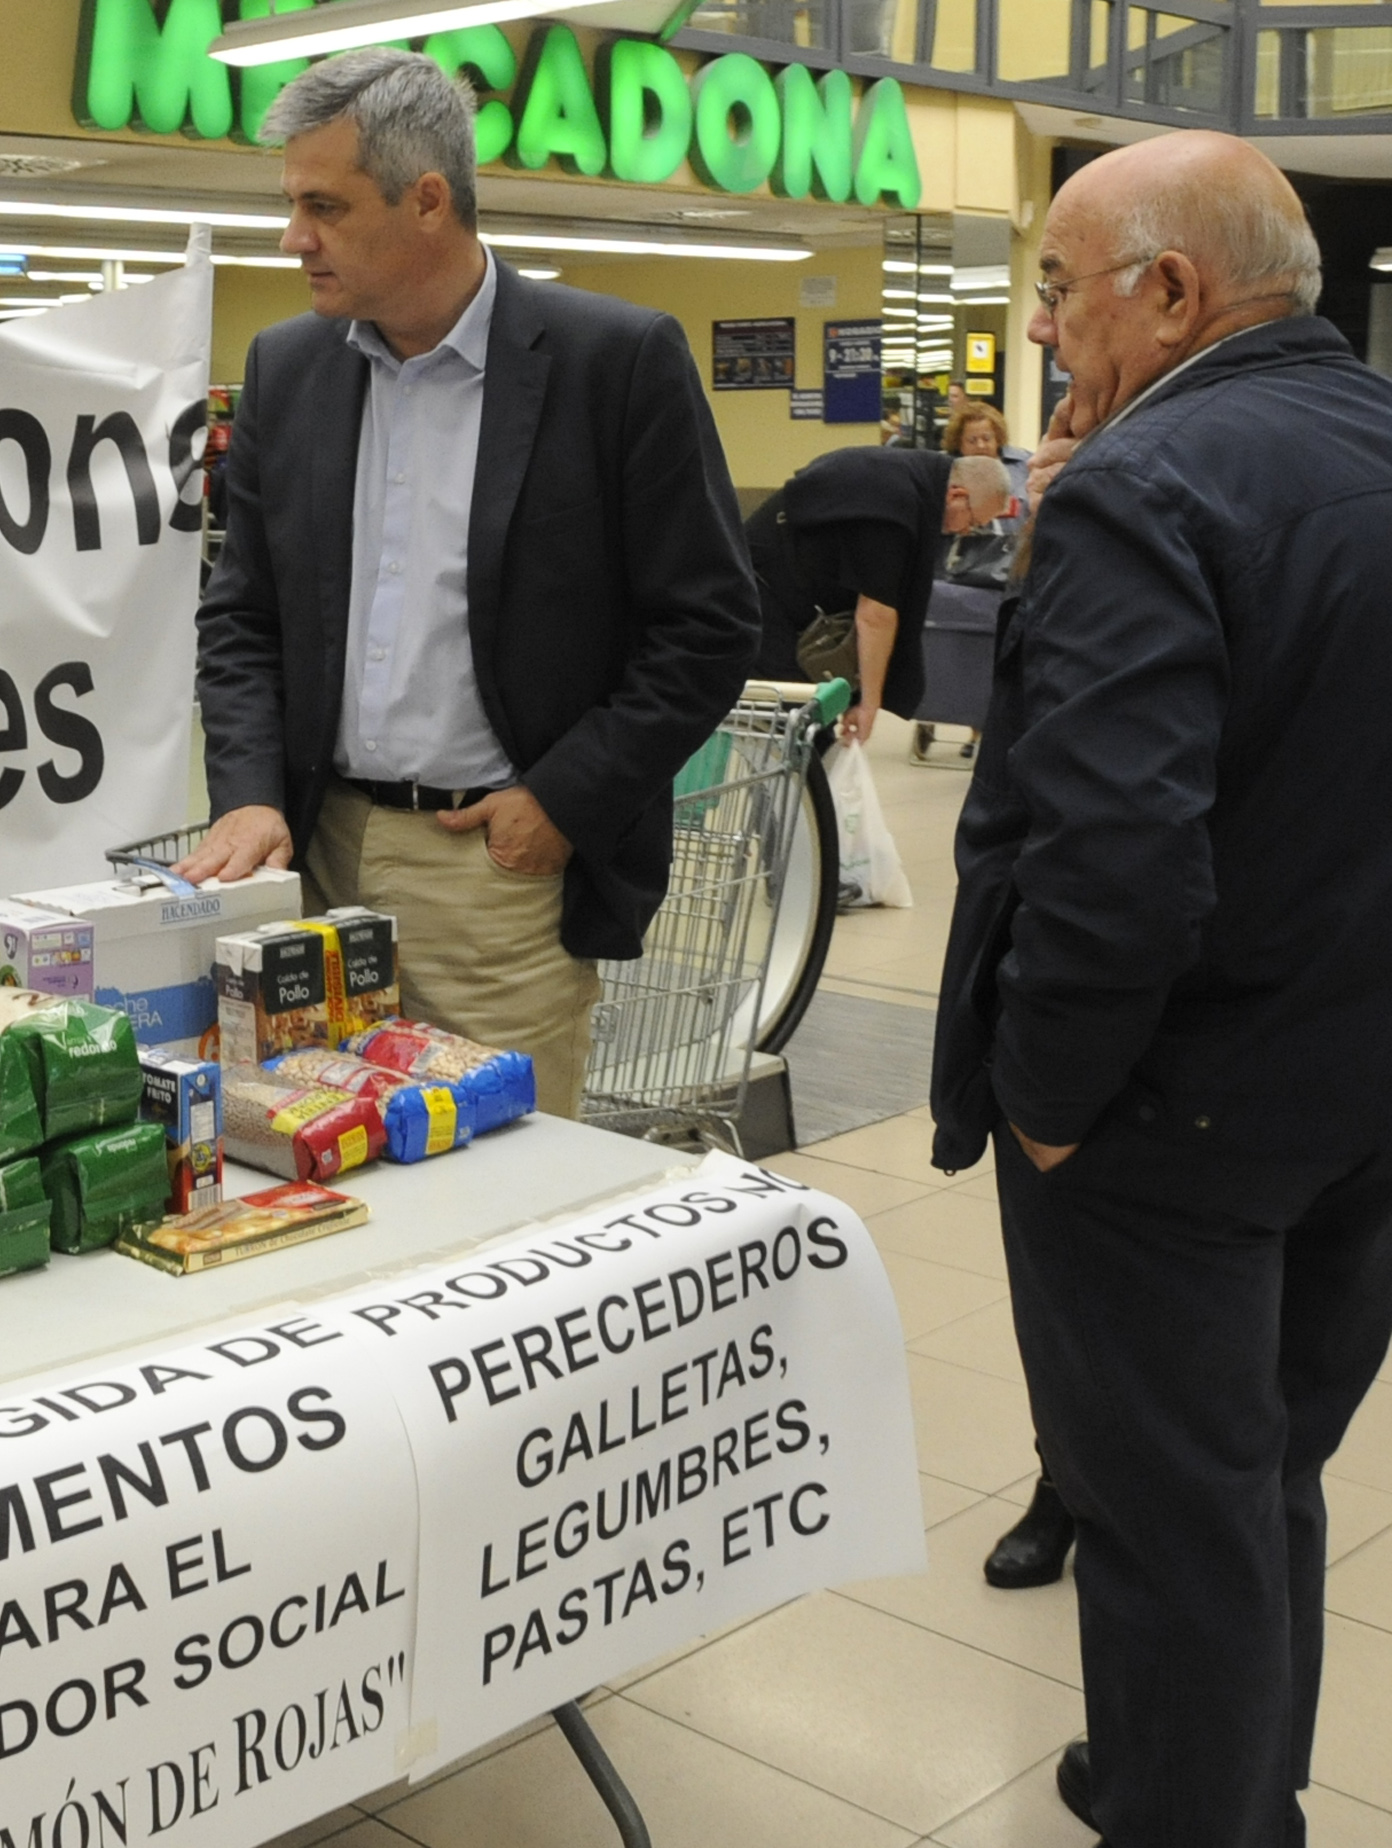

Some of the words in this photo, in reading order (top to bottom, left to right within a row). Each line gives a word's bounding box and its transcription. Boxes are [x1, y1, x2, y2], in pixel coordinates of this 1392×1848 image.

[72, 0, 922, 208] MCADONA
[278, 984, 310, 1004] Pollo
[349, 969, 379, 988] Pollo
[350, 1190, 738, 1338] PRODUCTOS
[428, 1215, 850, 1424] PERECEDEROS
[206, 1315, 344, 1369] DE
[515, 1323, 789, 1489] GALLETAS,
[164, 1526, 253, 1600] EL
[479, 1398, 831, 1600] LEGUMBRES,
[172, 1558, 407, 1691] SOCIAL
[482, 1538, 706, 1687] PASTAS,
[721, 1481, 832, 1568] ETC
[146, 1741, 221, 1838] DE
